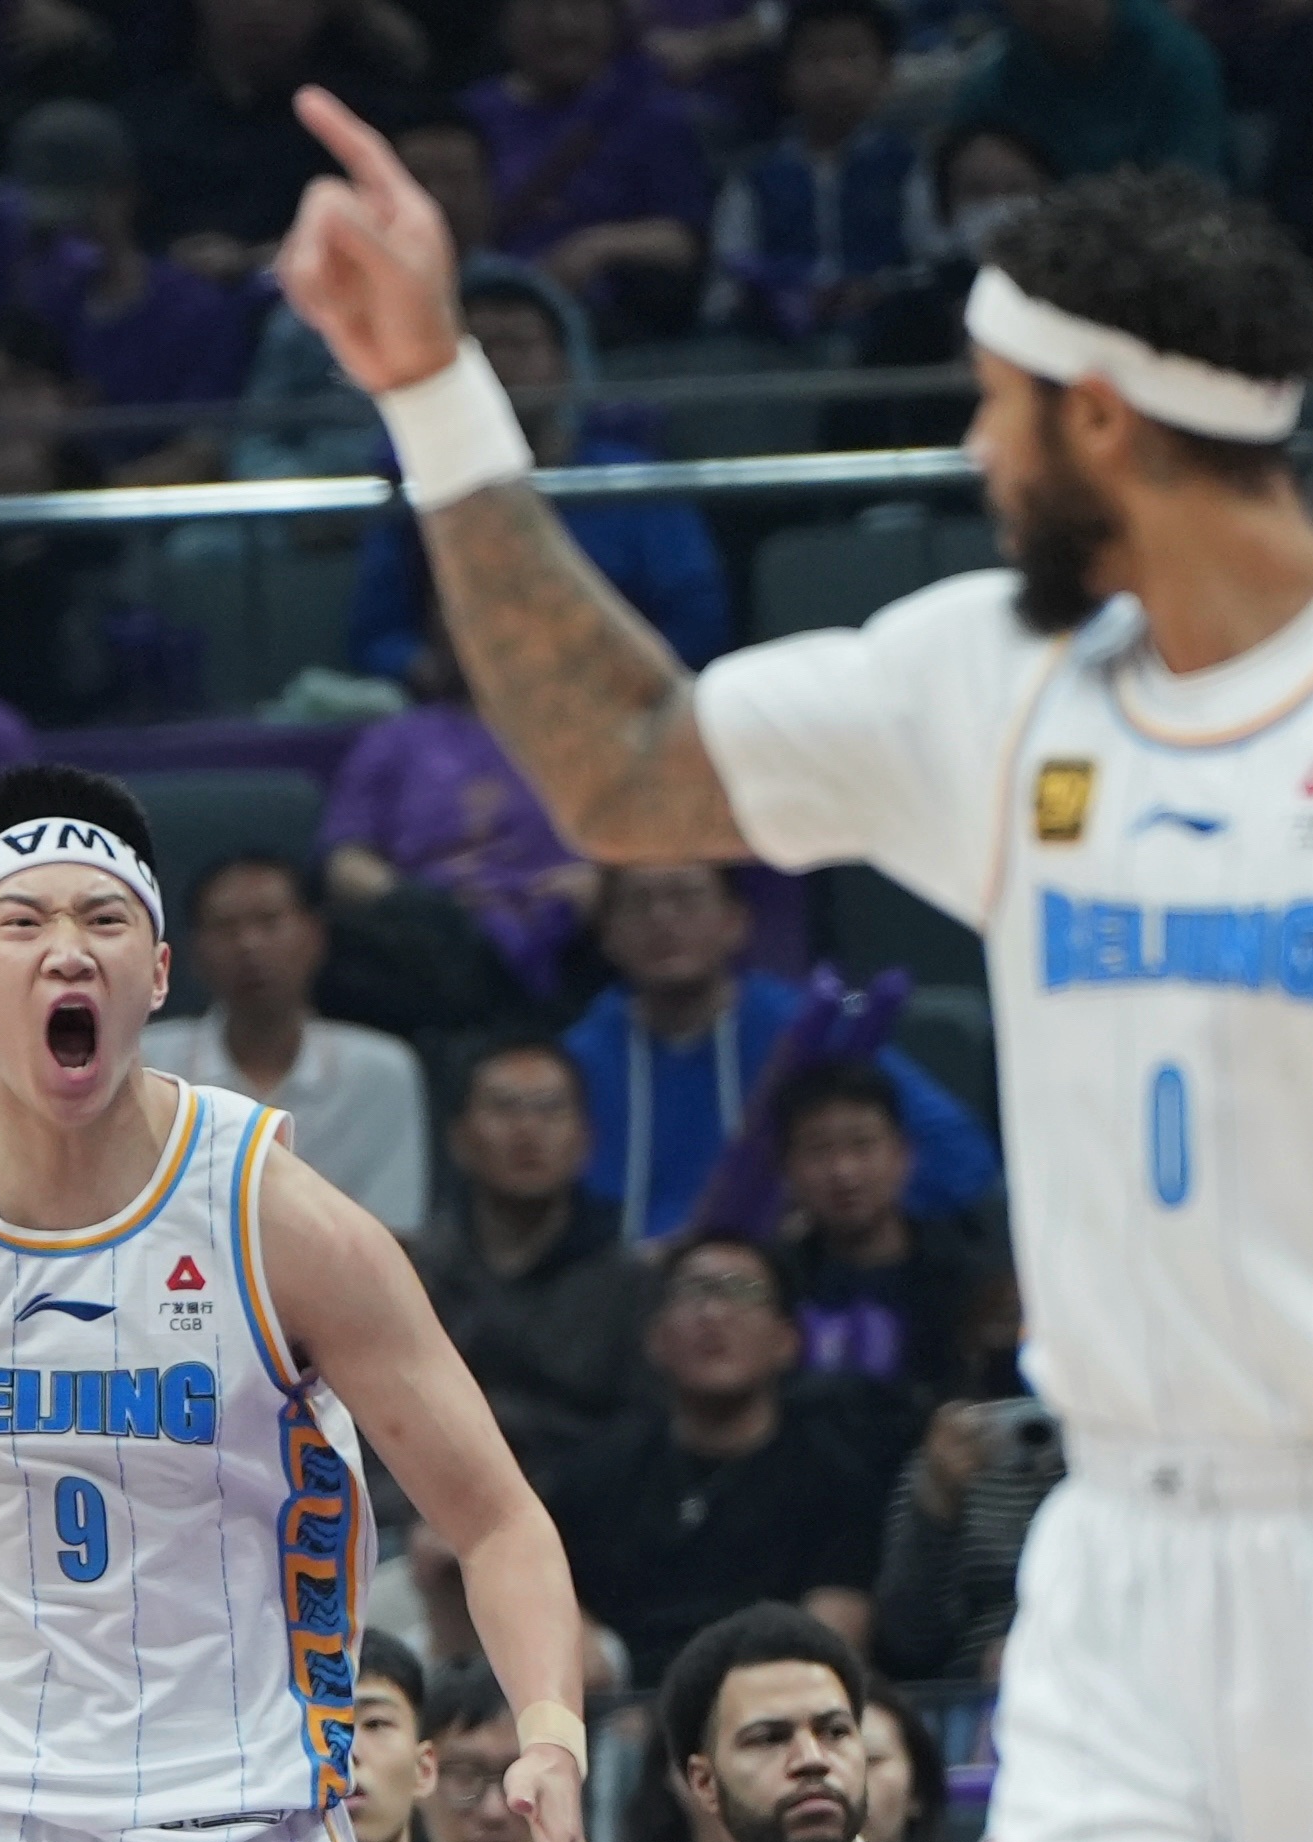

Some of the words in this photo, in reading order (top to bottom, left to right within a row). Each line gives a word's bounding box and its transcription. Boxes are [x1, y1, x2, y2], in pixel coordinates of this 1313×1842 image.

[1151, 1064, 1190, 1206] 0
[169, 1318, 202, 1331] CGB
[54, 1475, 108, 1583] 9
